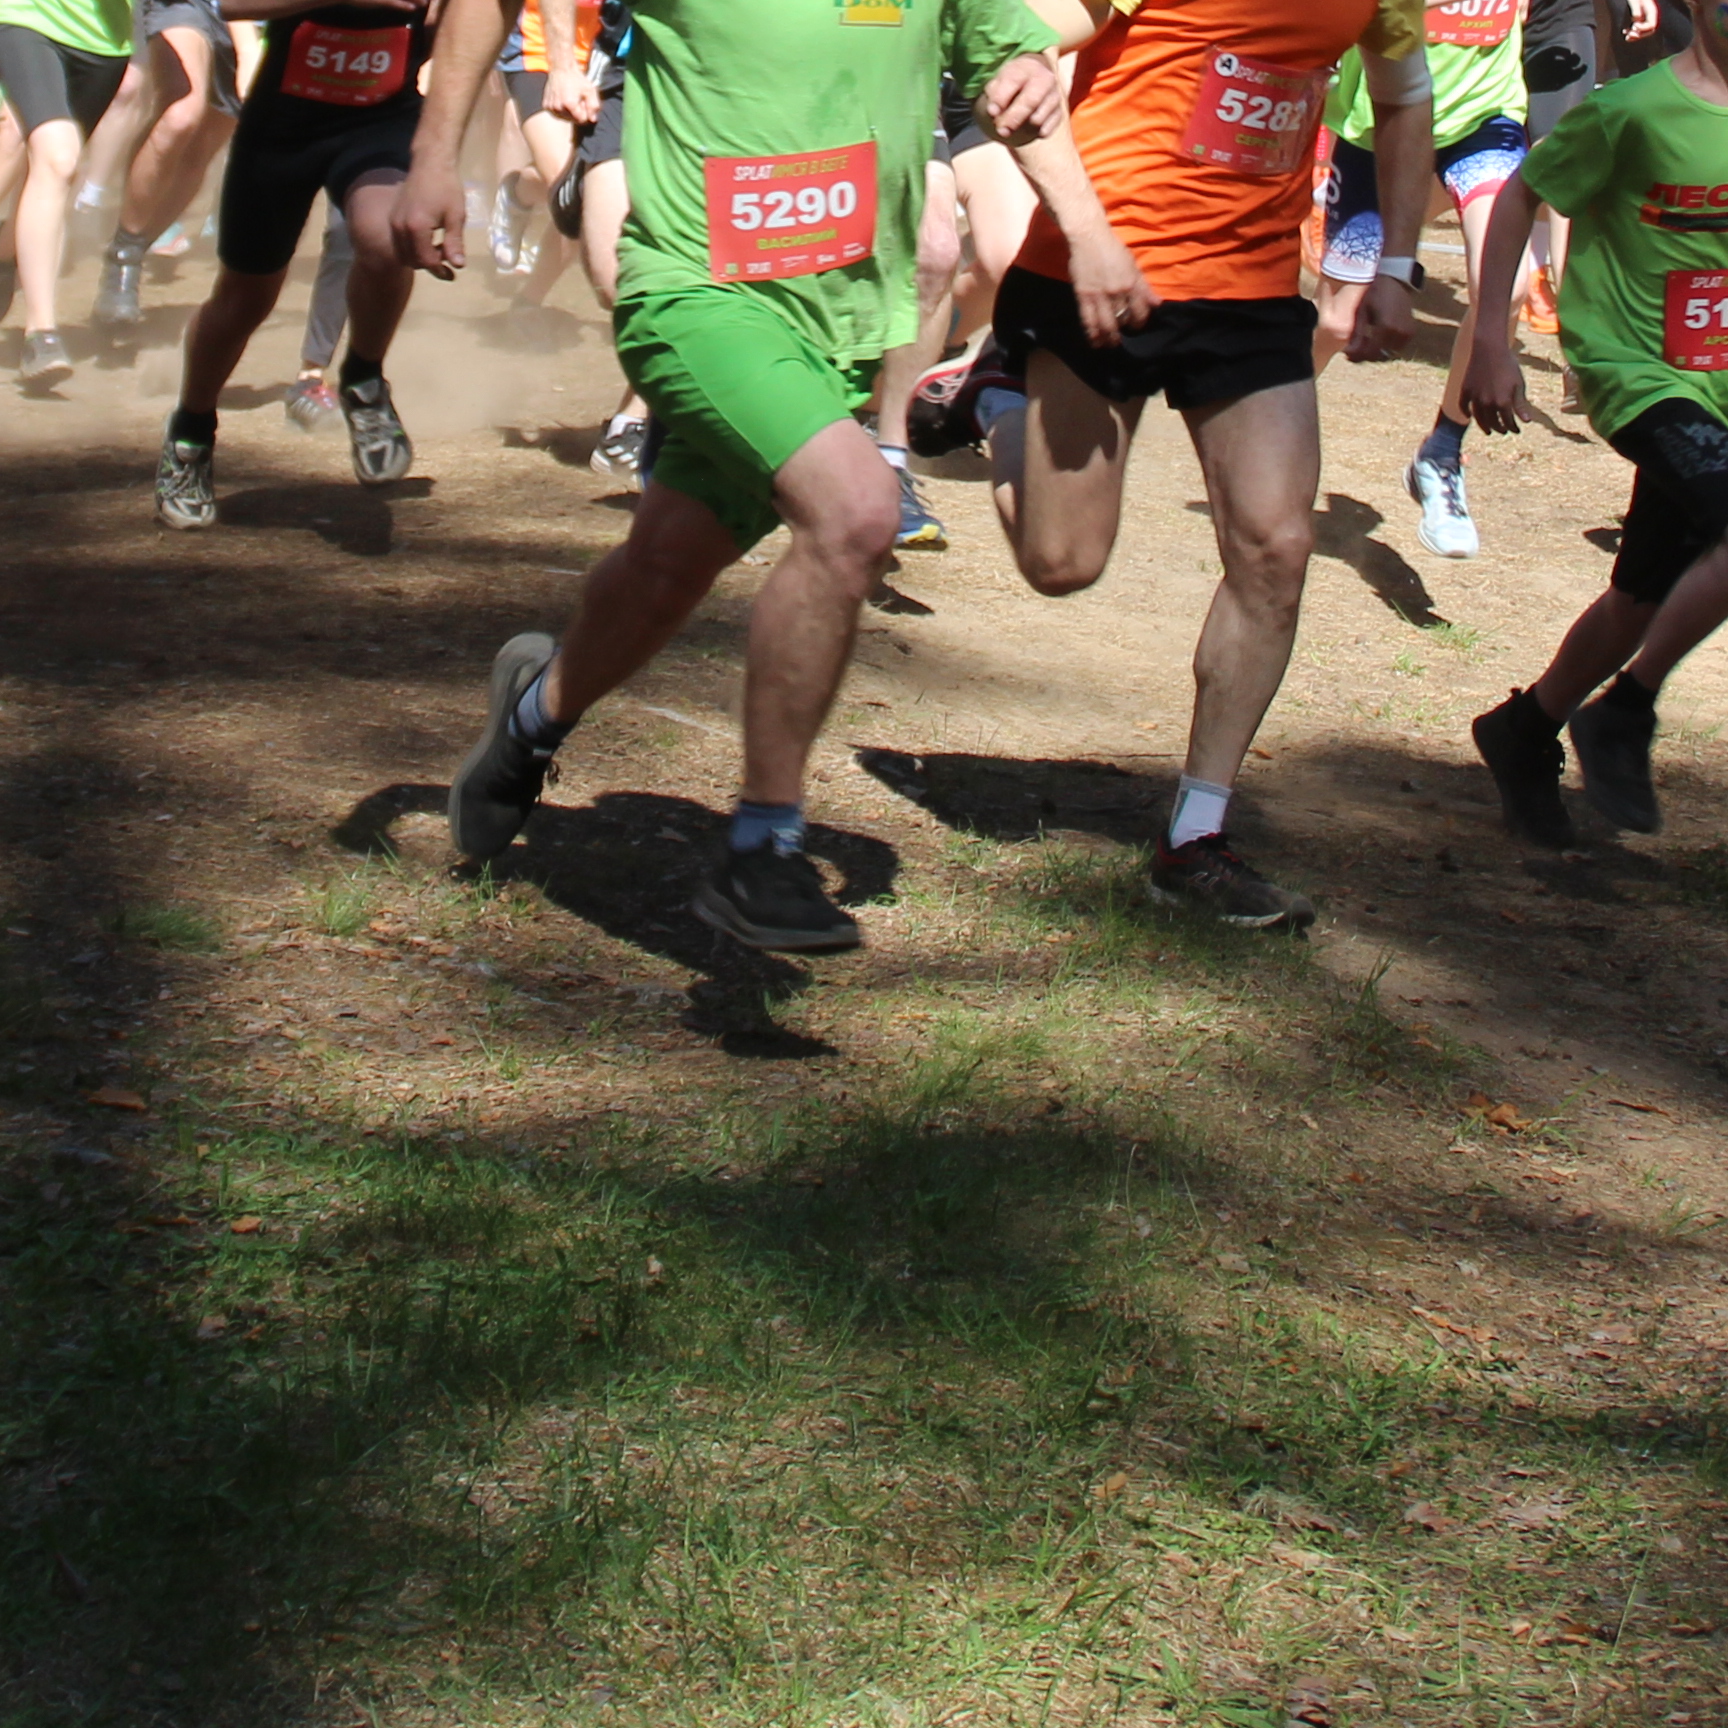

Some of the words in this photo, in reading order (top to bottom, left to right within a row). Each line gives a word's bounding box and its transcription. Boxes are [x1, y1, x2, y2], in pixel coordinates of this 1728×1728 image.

[305, 45, 392, 74] 5149
[1215, 87, 1308, 132] 5282
[730, 180, 858, 231] 5290
